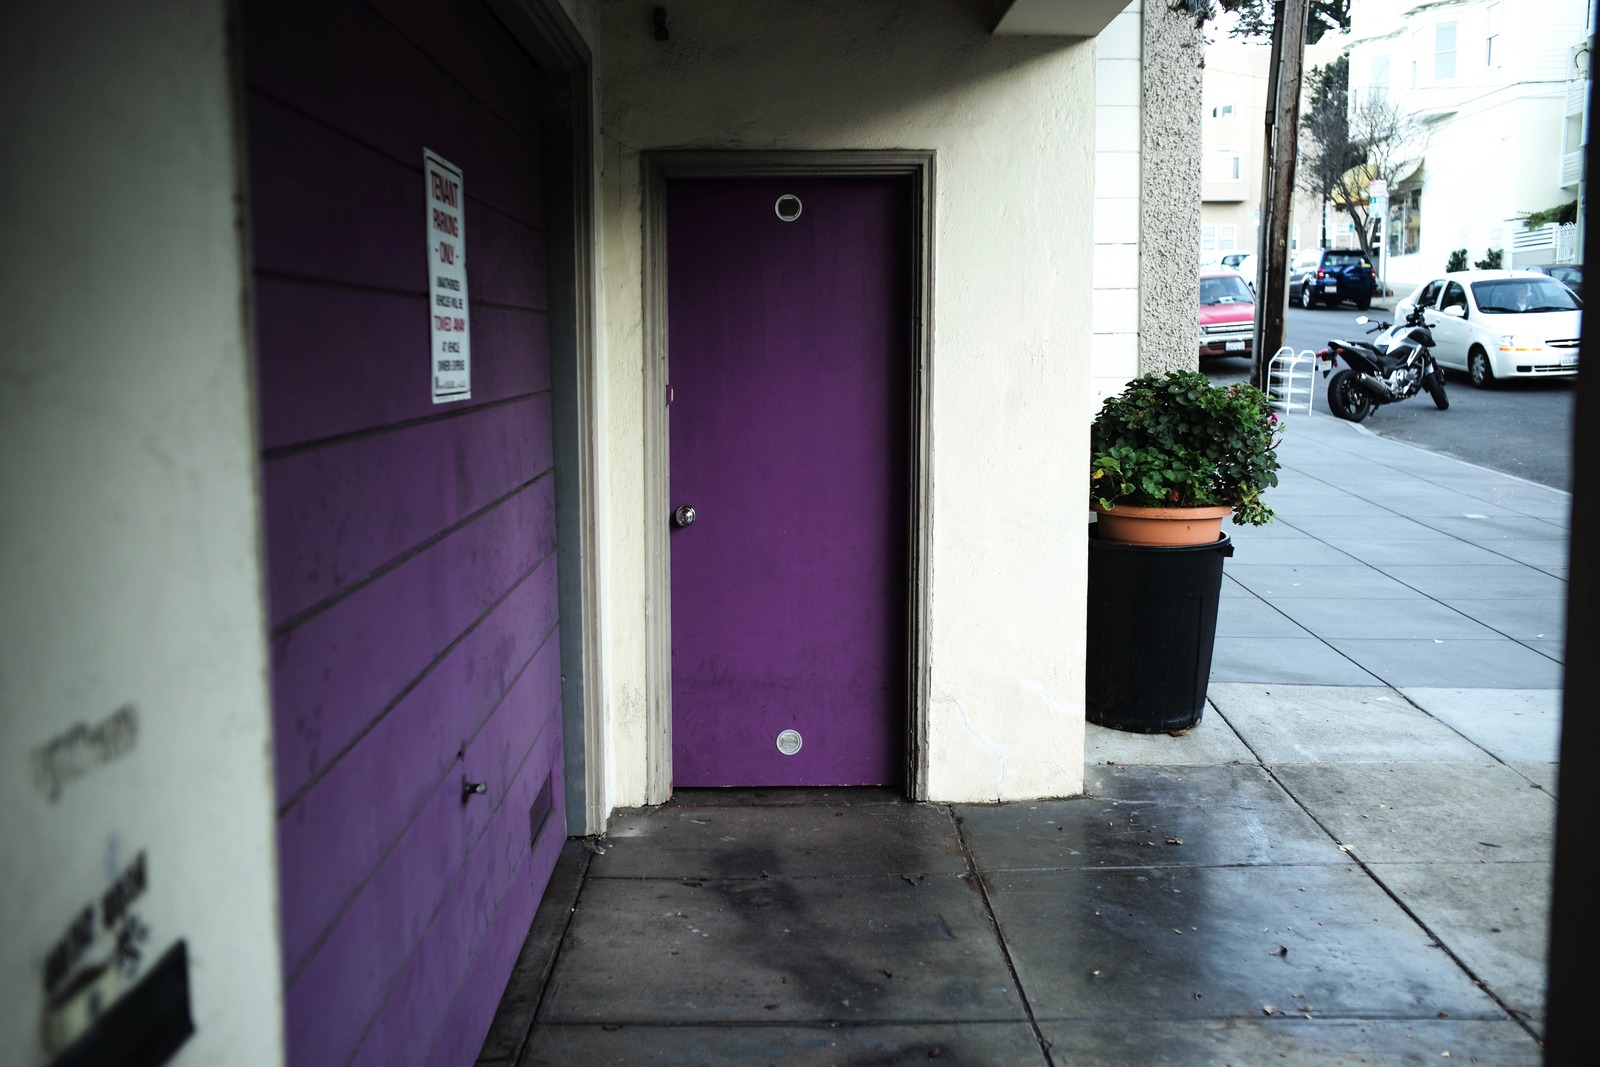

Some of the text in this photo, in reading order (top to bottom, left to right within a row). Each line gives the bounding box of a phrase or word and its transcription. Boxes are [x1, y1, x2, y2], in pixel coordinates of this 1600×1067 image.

[430, 169, 459, 209] TENANT
[433, 208, 459, 238] PARKING
[434, 315, 466, 333] TOWED AWAY
